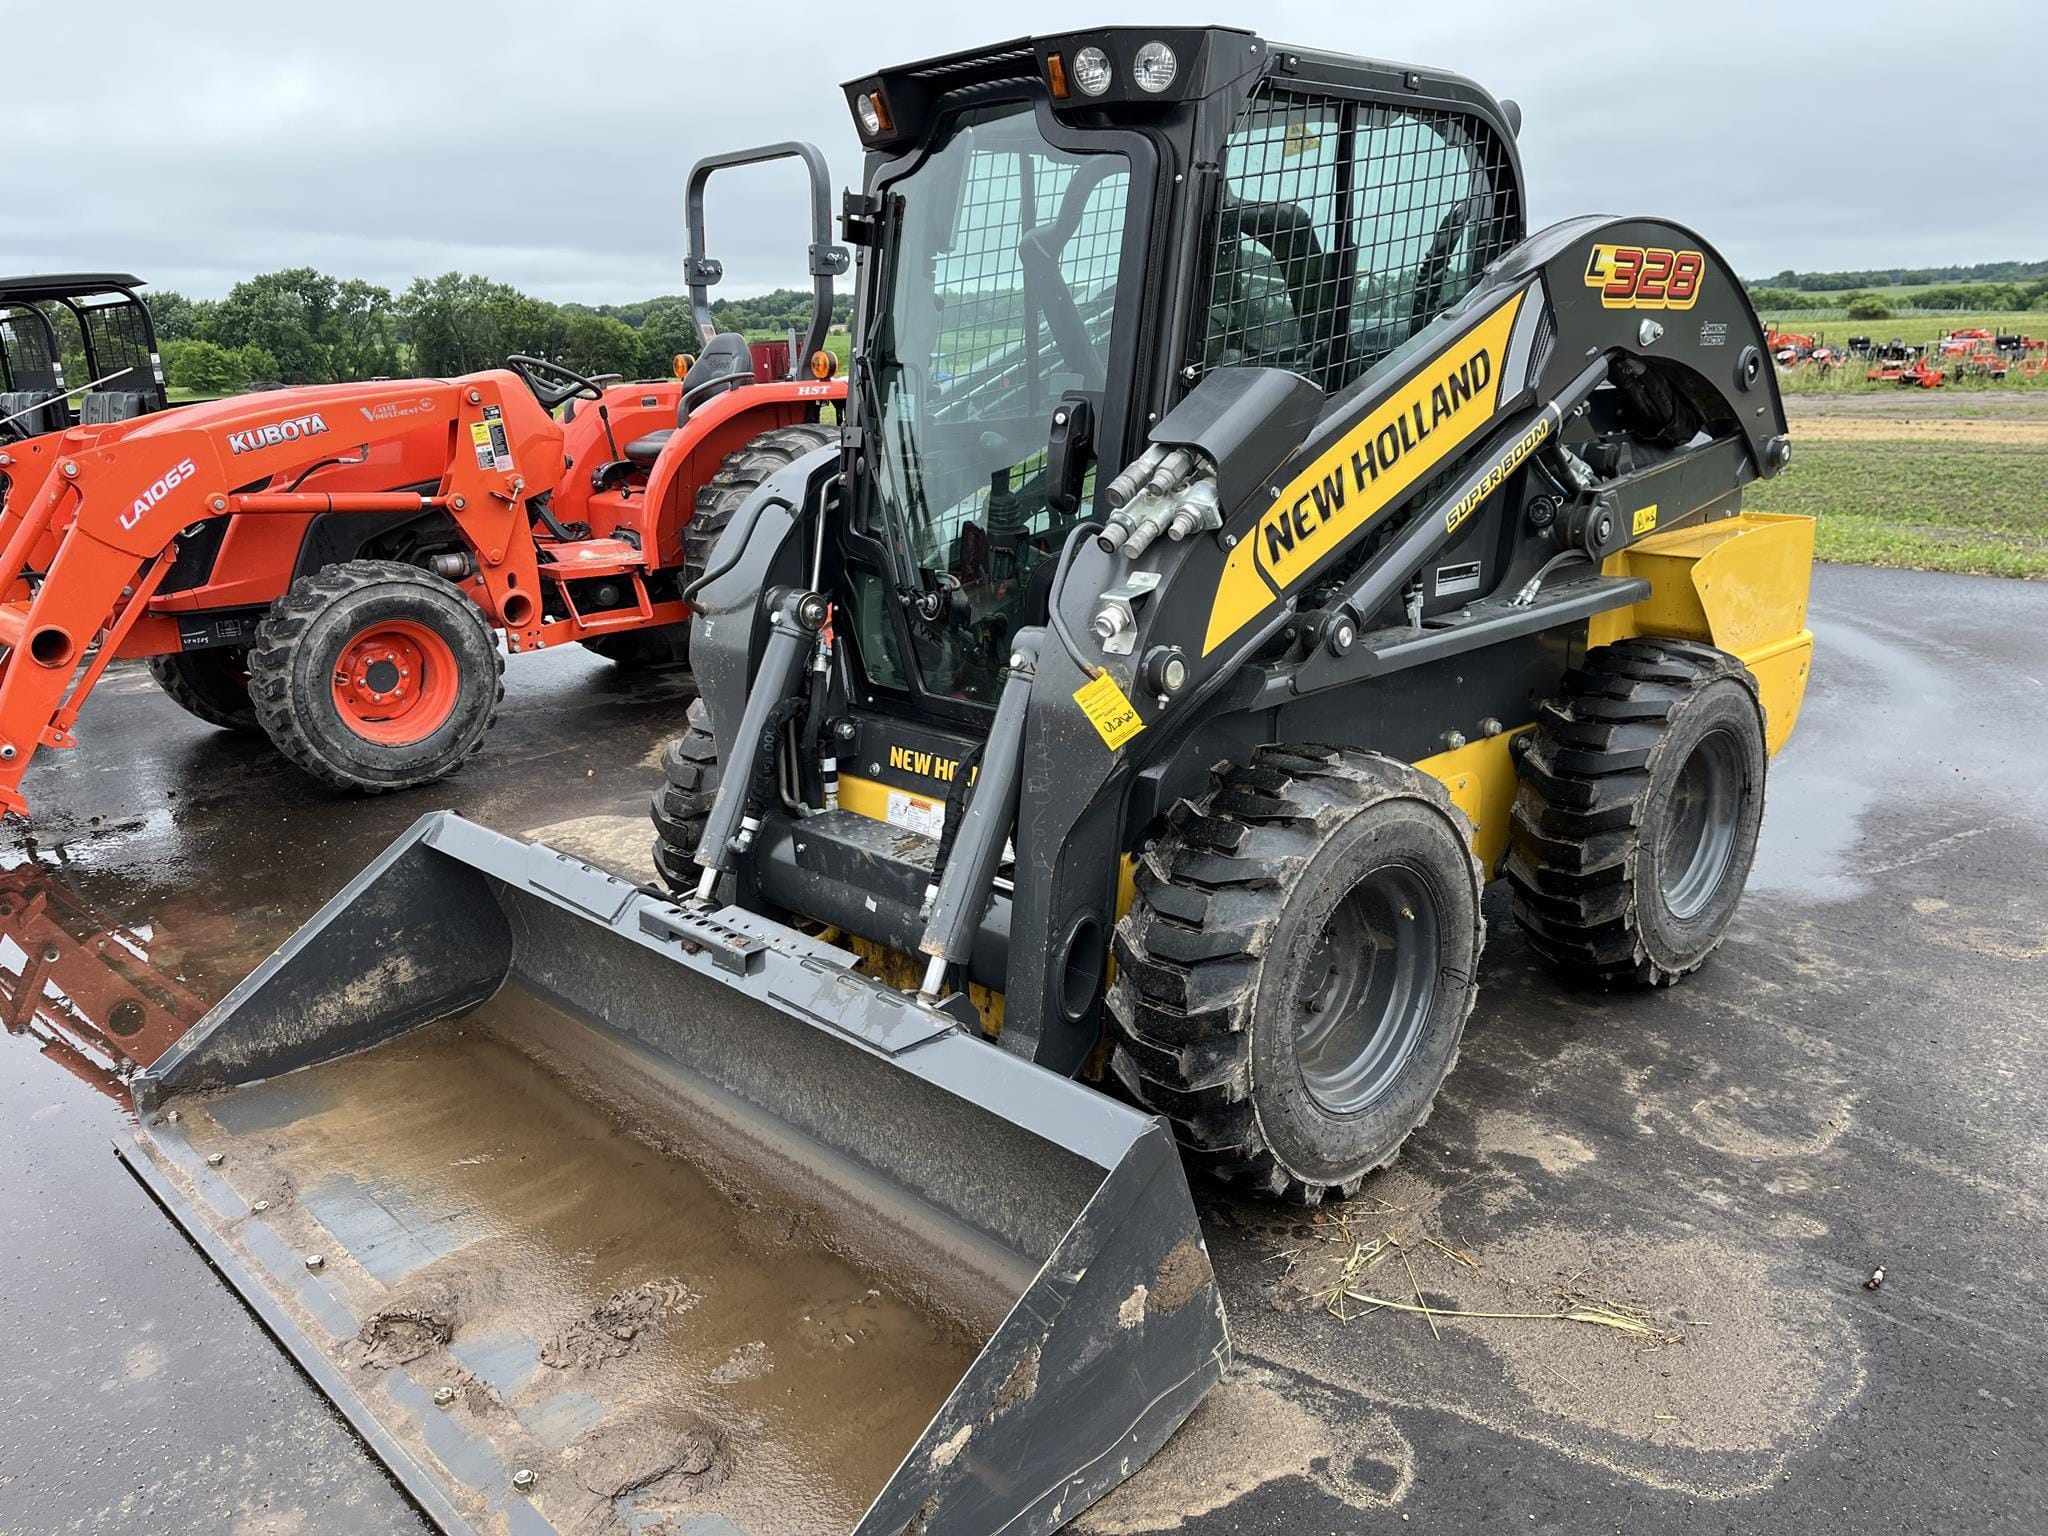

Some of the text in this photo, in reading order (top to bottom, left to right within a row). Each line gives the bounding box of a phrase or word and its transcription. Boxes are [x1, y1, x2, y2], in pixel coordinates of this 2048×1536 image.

[1585, 244, 1705, 310] L328
[797, 386, 830, 395] HST
[227, 413, 329, 456] KUBOTA
[1264, 348, 1491, 566] NEW HOLLAND
[119, 457, 196, 530] LA1065
[1446, 466, 1502, 533] SUPER
[1501, 419, 1548, 477] BOOM
[889, 746, 932, 776] NEW
